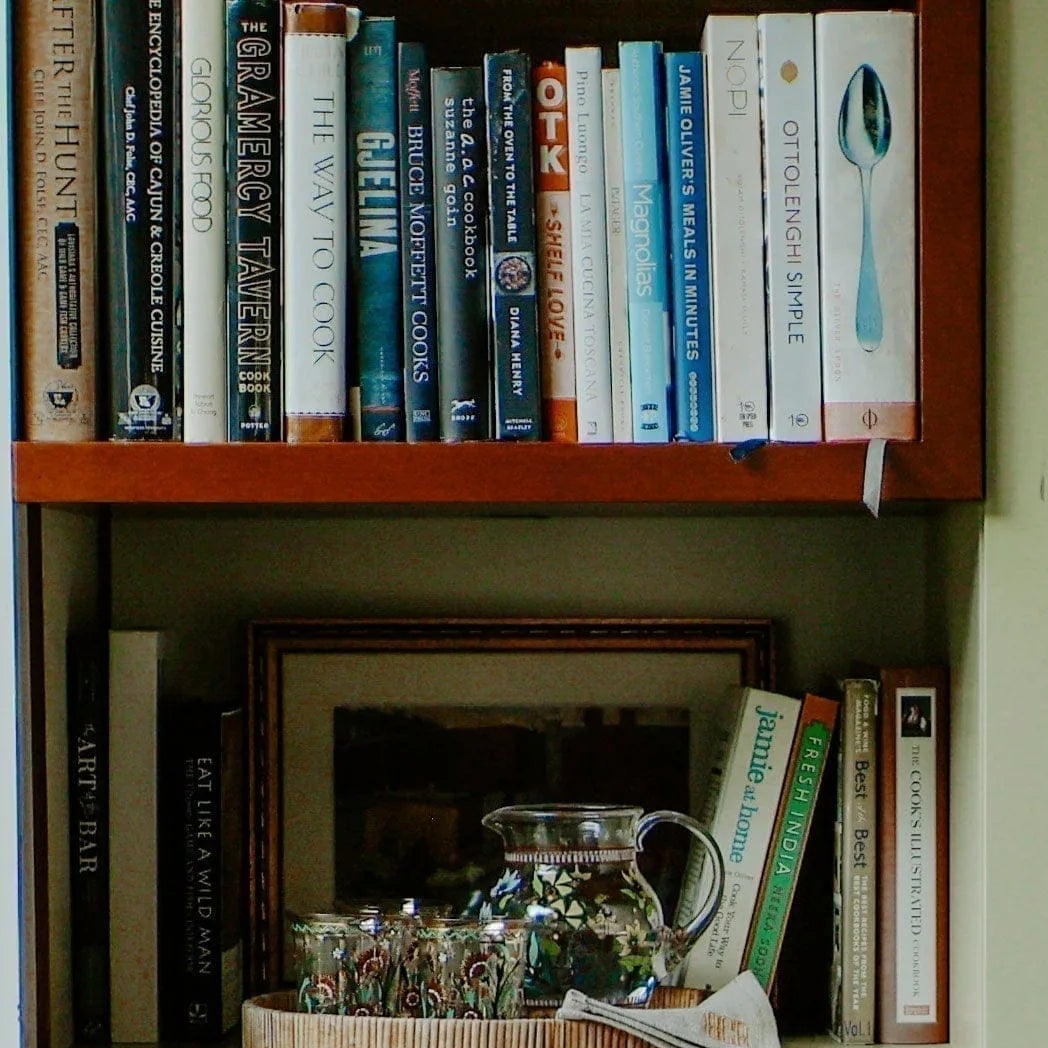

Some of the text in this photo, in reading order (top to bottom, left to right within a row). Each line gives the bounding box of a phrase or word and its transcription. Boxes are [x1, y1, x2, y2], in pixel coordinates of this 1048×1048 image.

[240, 22, 268, 33] THE
[149, 12, 162, 137] ENCYCLOPEDIA
[679, 64, 693, 114] JAMIE
[726, 40, 747, 115] NOPI
[52, 0, 79, 217] FTER THE HUNT
[124, 107, 136, 131] John
[462, 97, 476, 129] the
[537, 77, 567, 173] OTK
[150, 142, 162, 164] OF
[191, 57, 213, 233] GLORIOUS FOOD
[443, 97, 460, 228] suzanne goin
[502, 69, 518, 244] FROM THE OVEN TO THE TABLE
[680, 118, 695, 196] OLIVER'S
[126, 198, 136, 222] AAC
[147, 167, 163, 221] CAJUN
[237, 37, 276, 366] GRAMERCY TAVERN
[356, 132, 398, 258] GJELINA
[150, 225, 163, 238] &
[308, 92, 335, 366] THE WAY TO COOK
[407, 125, 429, 384] BRUCE MOFFETT COOKS
[463, 191, 478, 279] cookbook
[576, 71, 598, 403] Pino Luongo LA MIA CUCINA TOSCANA
[630, 184, 656, 298] Magnolias
[682, 203, 697, 259] MEALS
[783, 120, 804, 344] OTTOLENGHI SIMPLE
[151, 242, 163, 305] CREOLE
[546, 219, 565, 341] SHELF LOVE
[684, 264, 697, 281] IN
[151, 308, 164, 373] CUISINE
[509, 307, 523, 397] DIANA HENRY
[685, 285, 699, 361] MINUTES
[238, 383, 271, 393] BOOK
[239, 371, 271, 381] COOK
[78, 737, 97, 790] ART
[730, 705, 784, 863] jamie at home
[794, 736, 822, 802] FRESH
[855, 760, 870, 800] Best
[910, 744, 920, 766] THE
[79, 821, 98, 874] BAR
[197, 757, 213, 975] EAT LIKE A WILD MAN
[776, 811, 804, 876] INDIA
[854, 829, 869, 869] Best
[729, 883, 740, 907] Cook
[909, 832, 922, 936] ILLUSTRATED
[707, 939, 718, 957] Life
[718, 936, 730, 956] Way
[723, 911, 735, 933] Your
[715, 959, 722, 969] to
